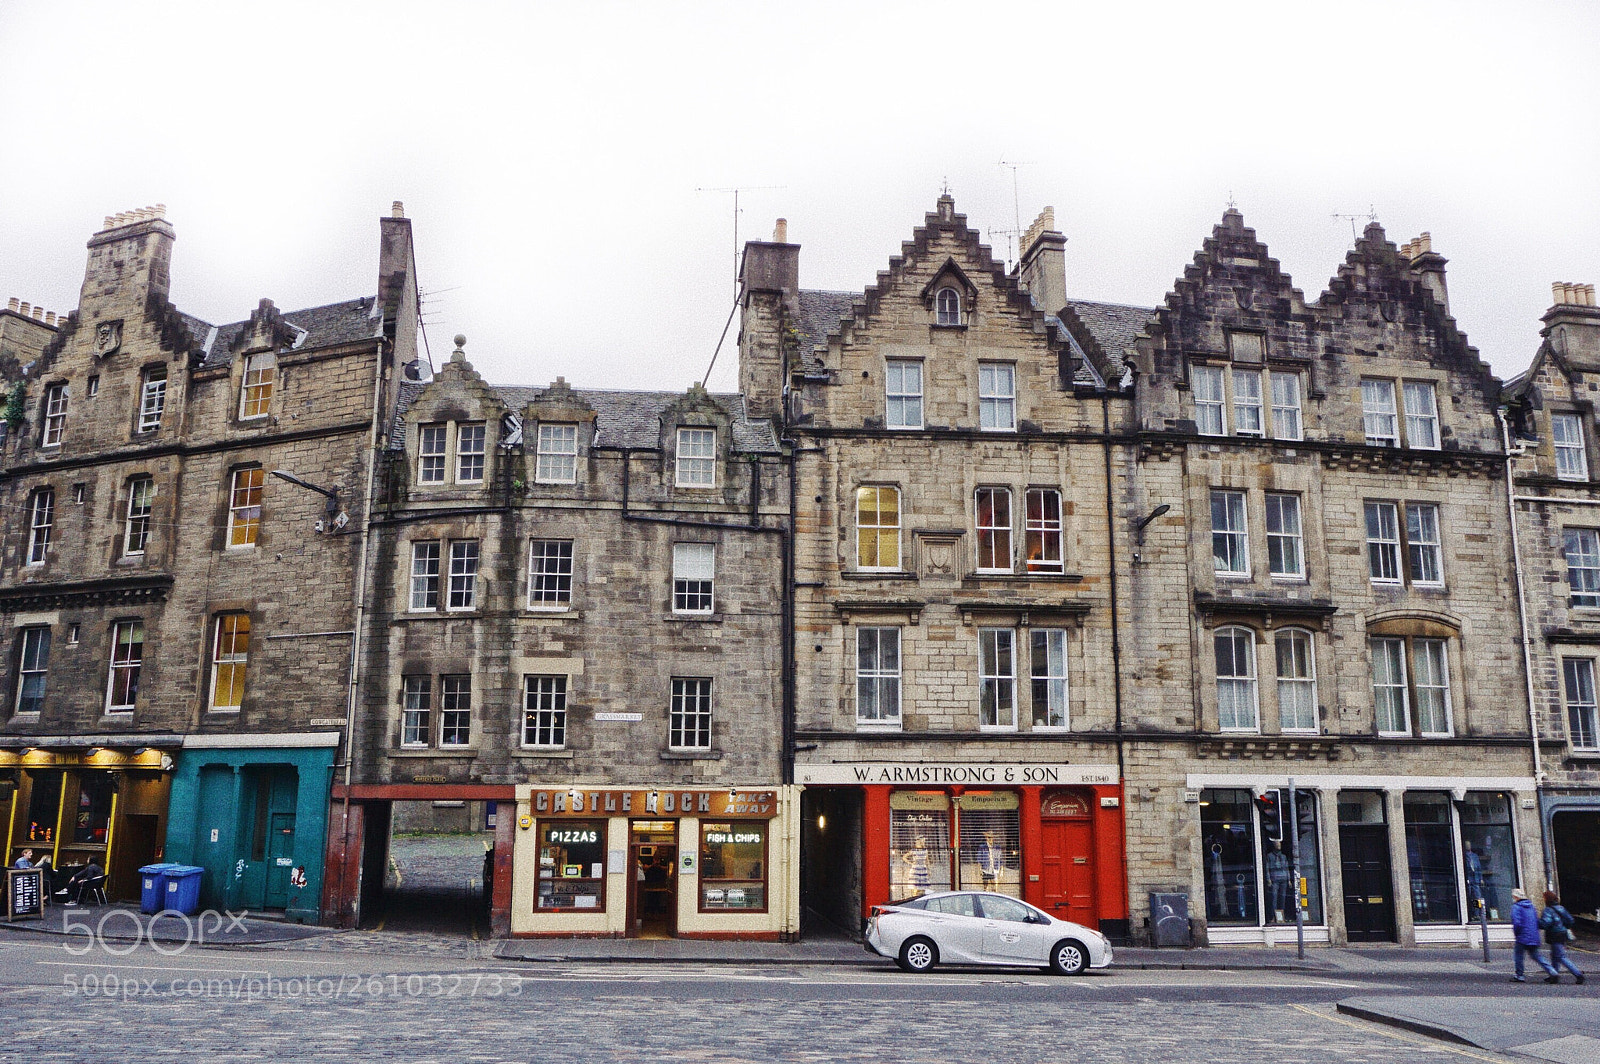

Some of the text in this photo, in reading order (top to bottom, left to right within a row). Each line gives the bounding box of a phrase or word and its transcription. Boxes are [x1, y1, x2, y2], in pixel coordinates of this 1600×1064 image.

[854, 767, 1058, 782] W. ARMSTRONG & SON
[728, 793, 768, 803] TAKE
[906, 795, 933, 803] Vintage
[971, 795, 1007, 804] Emporium
[537, 792, 710, 815] CASTLE ROCK
[724, 804, 770, 813] AWAY
[551, 831, 597, 843] PIZZAS
[707, 833, 760, 843] FISH & CHIPS
